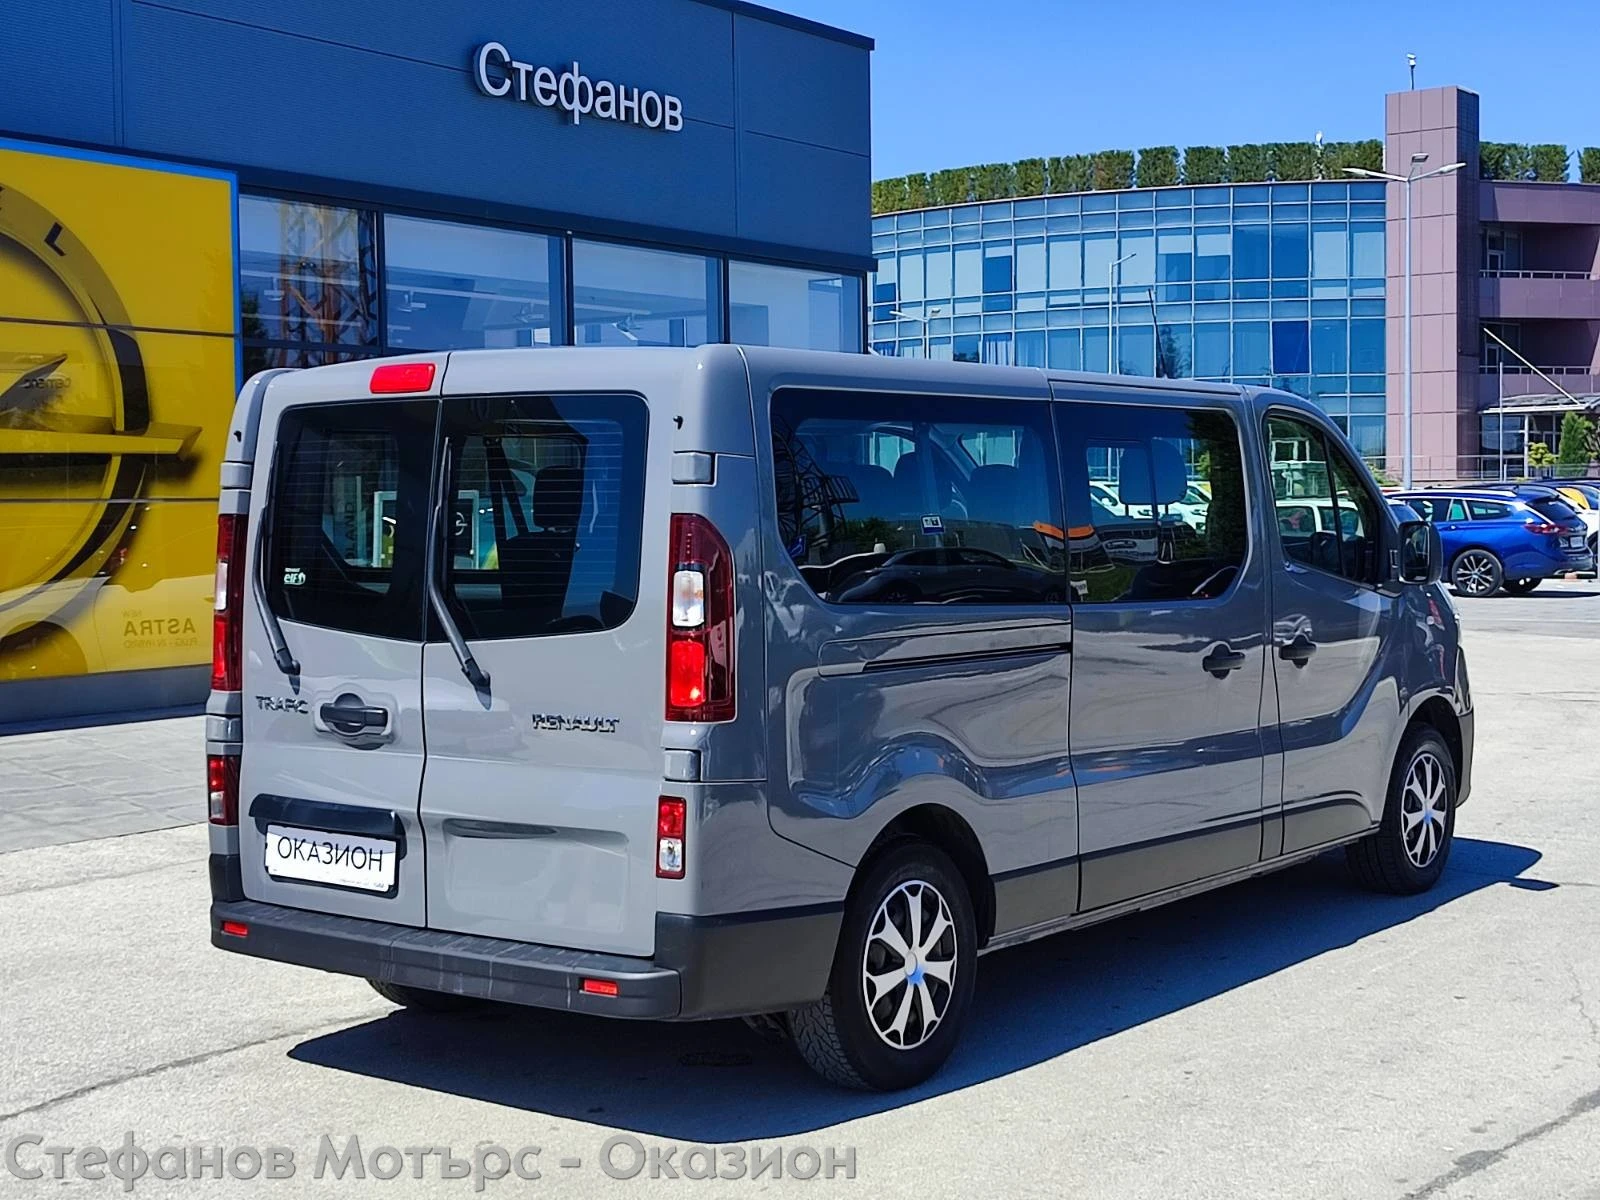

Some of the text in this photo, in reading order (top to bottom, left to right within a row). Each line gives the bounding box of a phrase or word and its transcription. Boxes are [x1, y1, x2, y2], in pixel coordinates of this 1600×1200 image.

[476, 41, 684, 132] Стефанов
[532, 713, 620, 733] RENAULT
[277, 836, 383, 872] ОКАЗИОН
